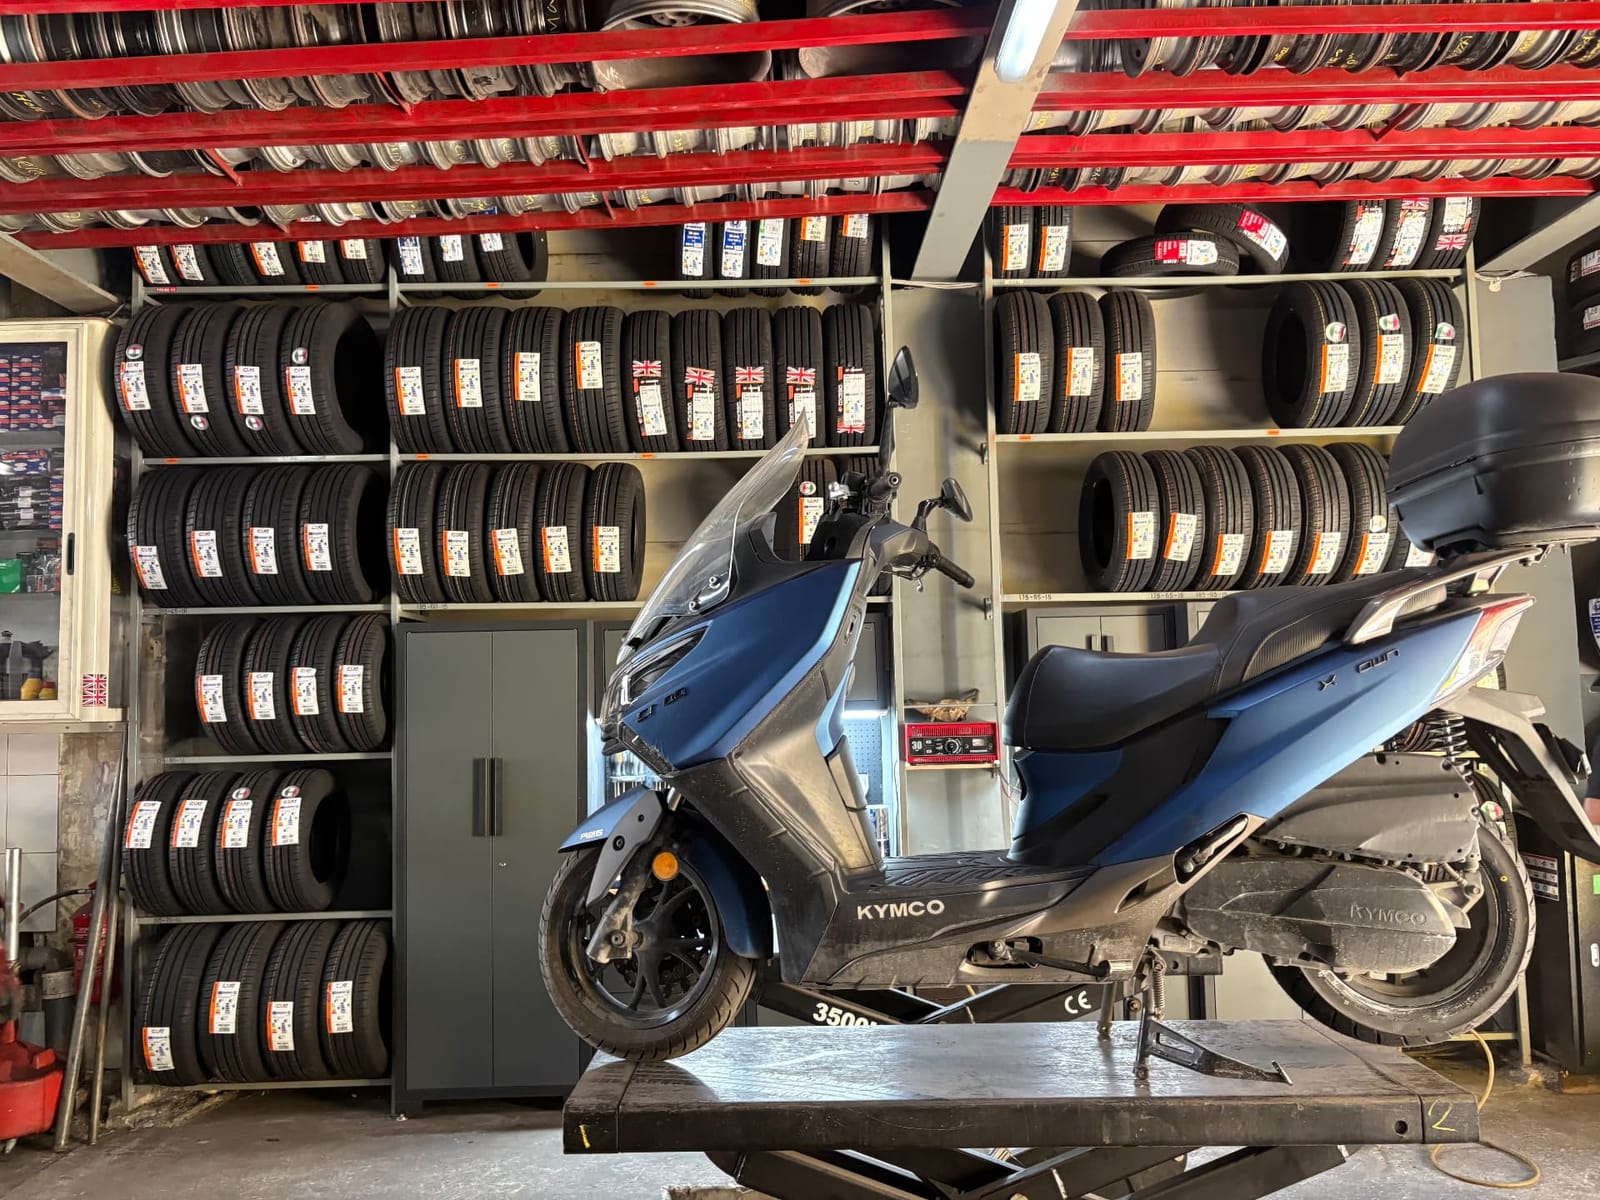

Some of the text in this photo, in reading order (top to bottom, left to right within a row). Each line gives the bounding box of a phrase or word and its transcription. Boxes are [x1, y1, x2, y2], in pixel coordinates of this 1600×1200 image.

[911, 740, 923, 750] 30
[857, 899, 945, 920] KYMCO
[1350, 903, 1427, 926] KYMCO
[815, 1005, 894, 1034] 3500
[1427, 1099, 1457, 1132] 2
